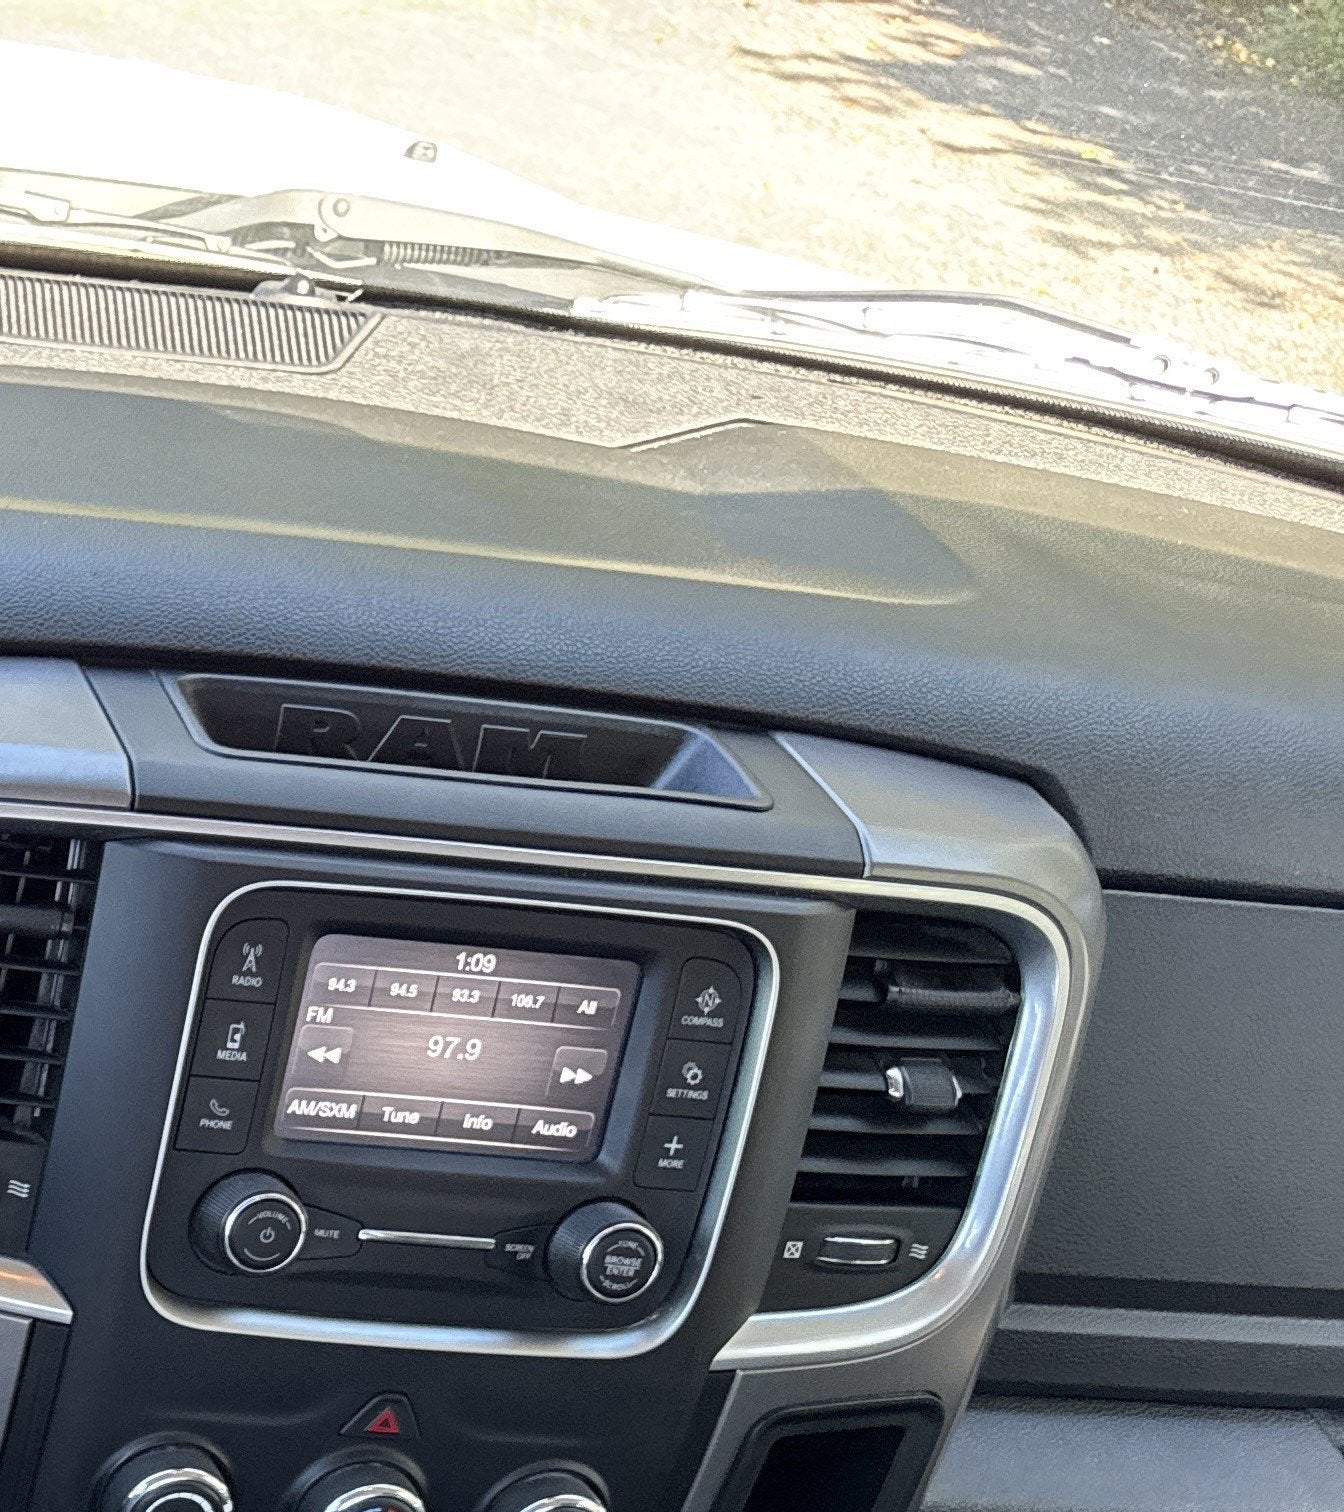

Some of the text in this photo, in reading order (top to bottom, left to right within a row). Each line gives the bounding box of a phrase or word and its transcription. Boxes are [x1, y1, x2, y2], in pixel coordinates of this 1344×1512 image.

[273, 703, 588, 779] RAM
[455, 951, 497, 974] 1:09
[232, 974, 263, 988] RADIO
[577, 999, 598, 1015] All
[305, 1006, 335, 1024] FM
[681, 1015, 724, 1028] COMPASS
[426, 1035, 483, 1061] 97.9
[216, 1050, 248, 1062] MEDIA
[666, 1088, 709, 1100] SETTINGS
[199, 1118, 234, 1130] PHONE
[287, 1099, 578, 1138] AM/SXM Tune Info Audio
[657, 1158, 685, 1169] MORE
[313, 1228, 340, 1239] MUTE
